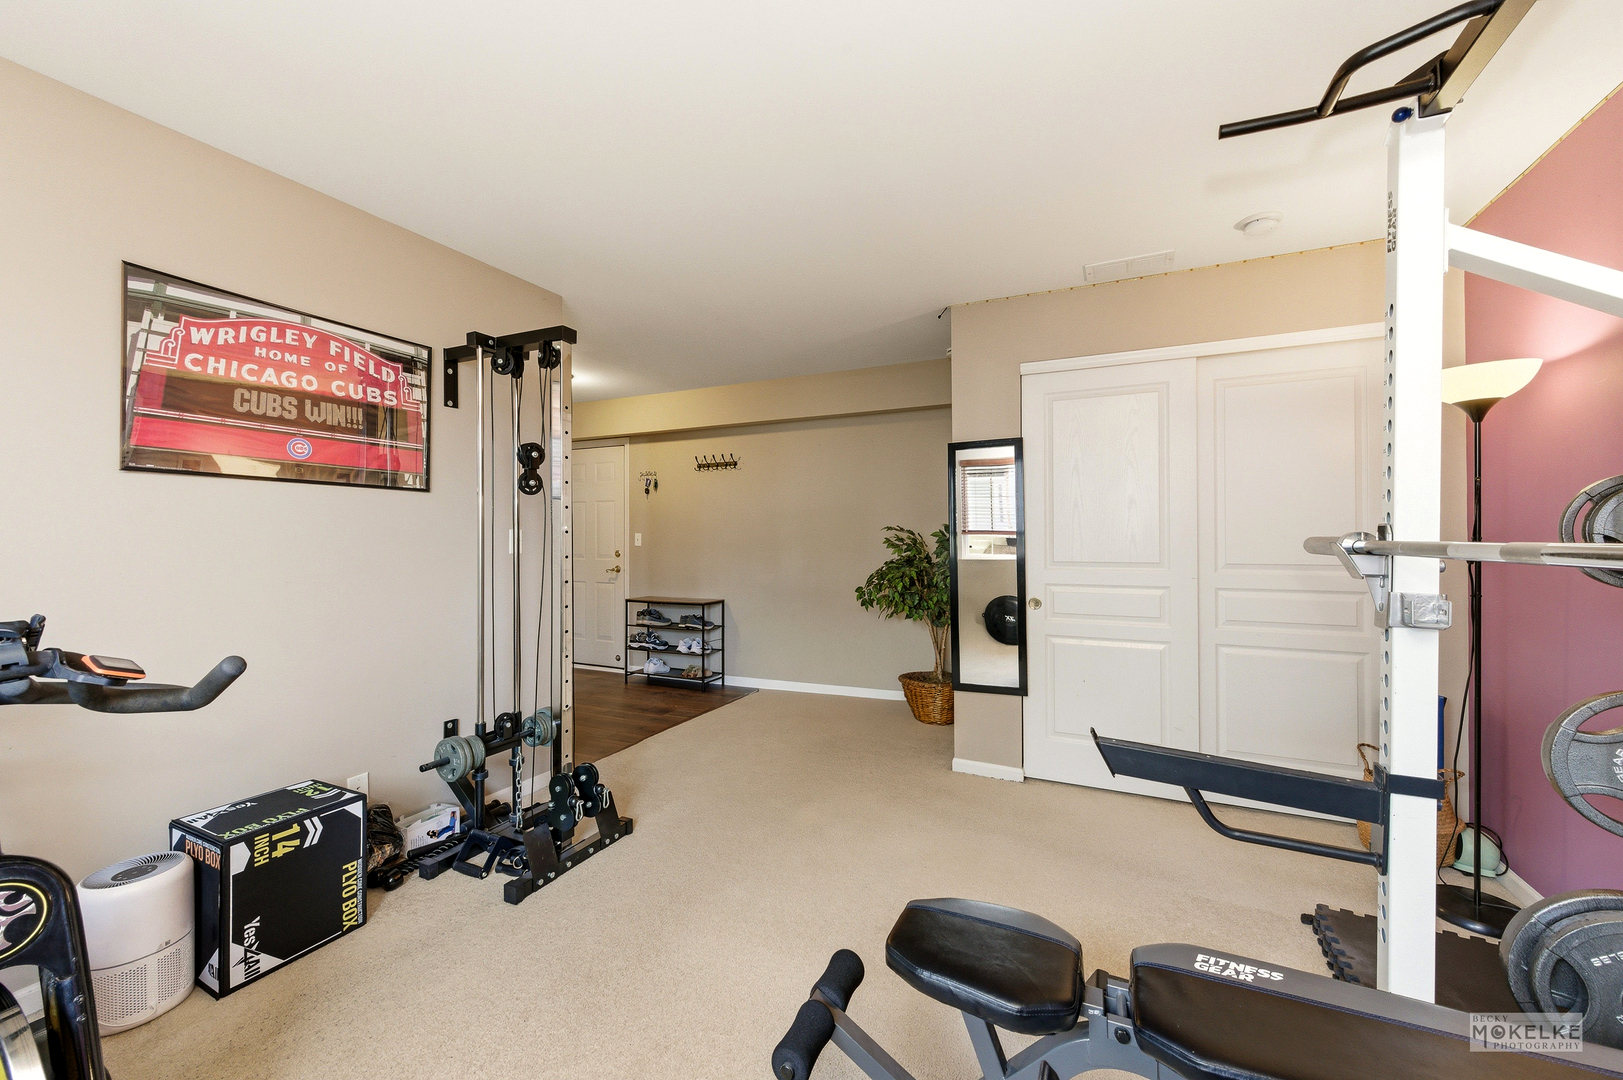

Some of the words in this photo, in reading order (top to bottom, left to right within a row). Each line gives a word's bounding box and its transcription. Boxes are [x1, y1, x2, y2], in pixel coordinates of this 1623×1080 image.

[189, 325, 318, 350] WRIGLEY
[329, 339, 397, 384] FIELD
[254, 346, 311, 367] HOME
[324, 361, 348, 374] OF
[184, 352, 319, 391] CHICAGO
[331, 380, 399, 406] CUBS
[232, 387, 298, 420] CUBS
[304, 399, 364, 430] WIN!!!
[185, 839, 204, 863] PLYO
[205, 848, 220, 871] BOX
[254, 832, 270, 867] INCH
[271, 823, 300, 858] 14
[342, 860, 358, 899] PLYO
[342, 897, 358, 932] BOX
[1193, 962, 1254, 982] GEAR
[1194, 953, 1284, 981] FITNESS
